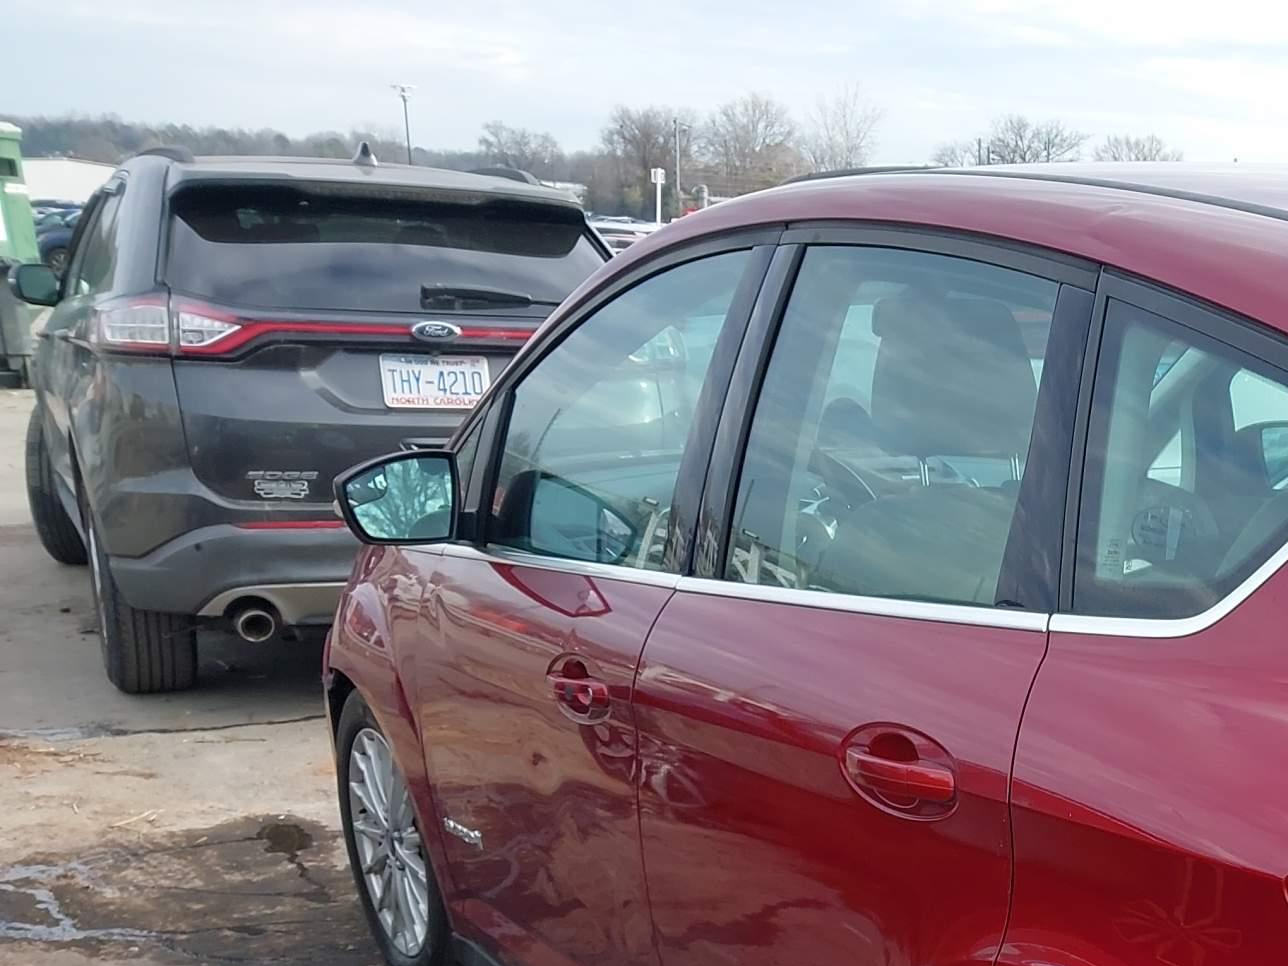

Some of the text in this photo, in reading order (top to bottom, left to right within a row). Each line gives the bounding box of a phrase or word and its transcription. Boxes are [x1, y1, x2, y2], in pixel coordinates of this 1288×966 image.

[424, 325, 449, 337] Ford
[387, 368, 484, 396] THY-4210
[391, 397, 430, 405] NORTH
